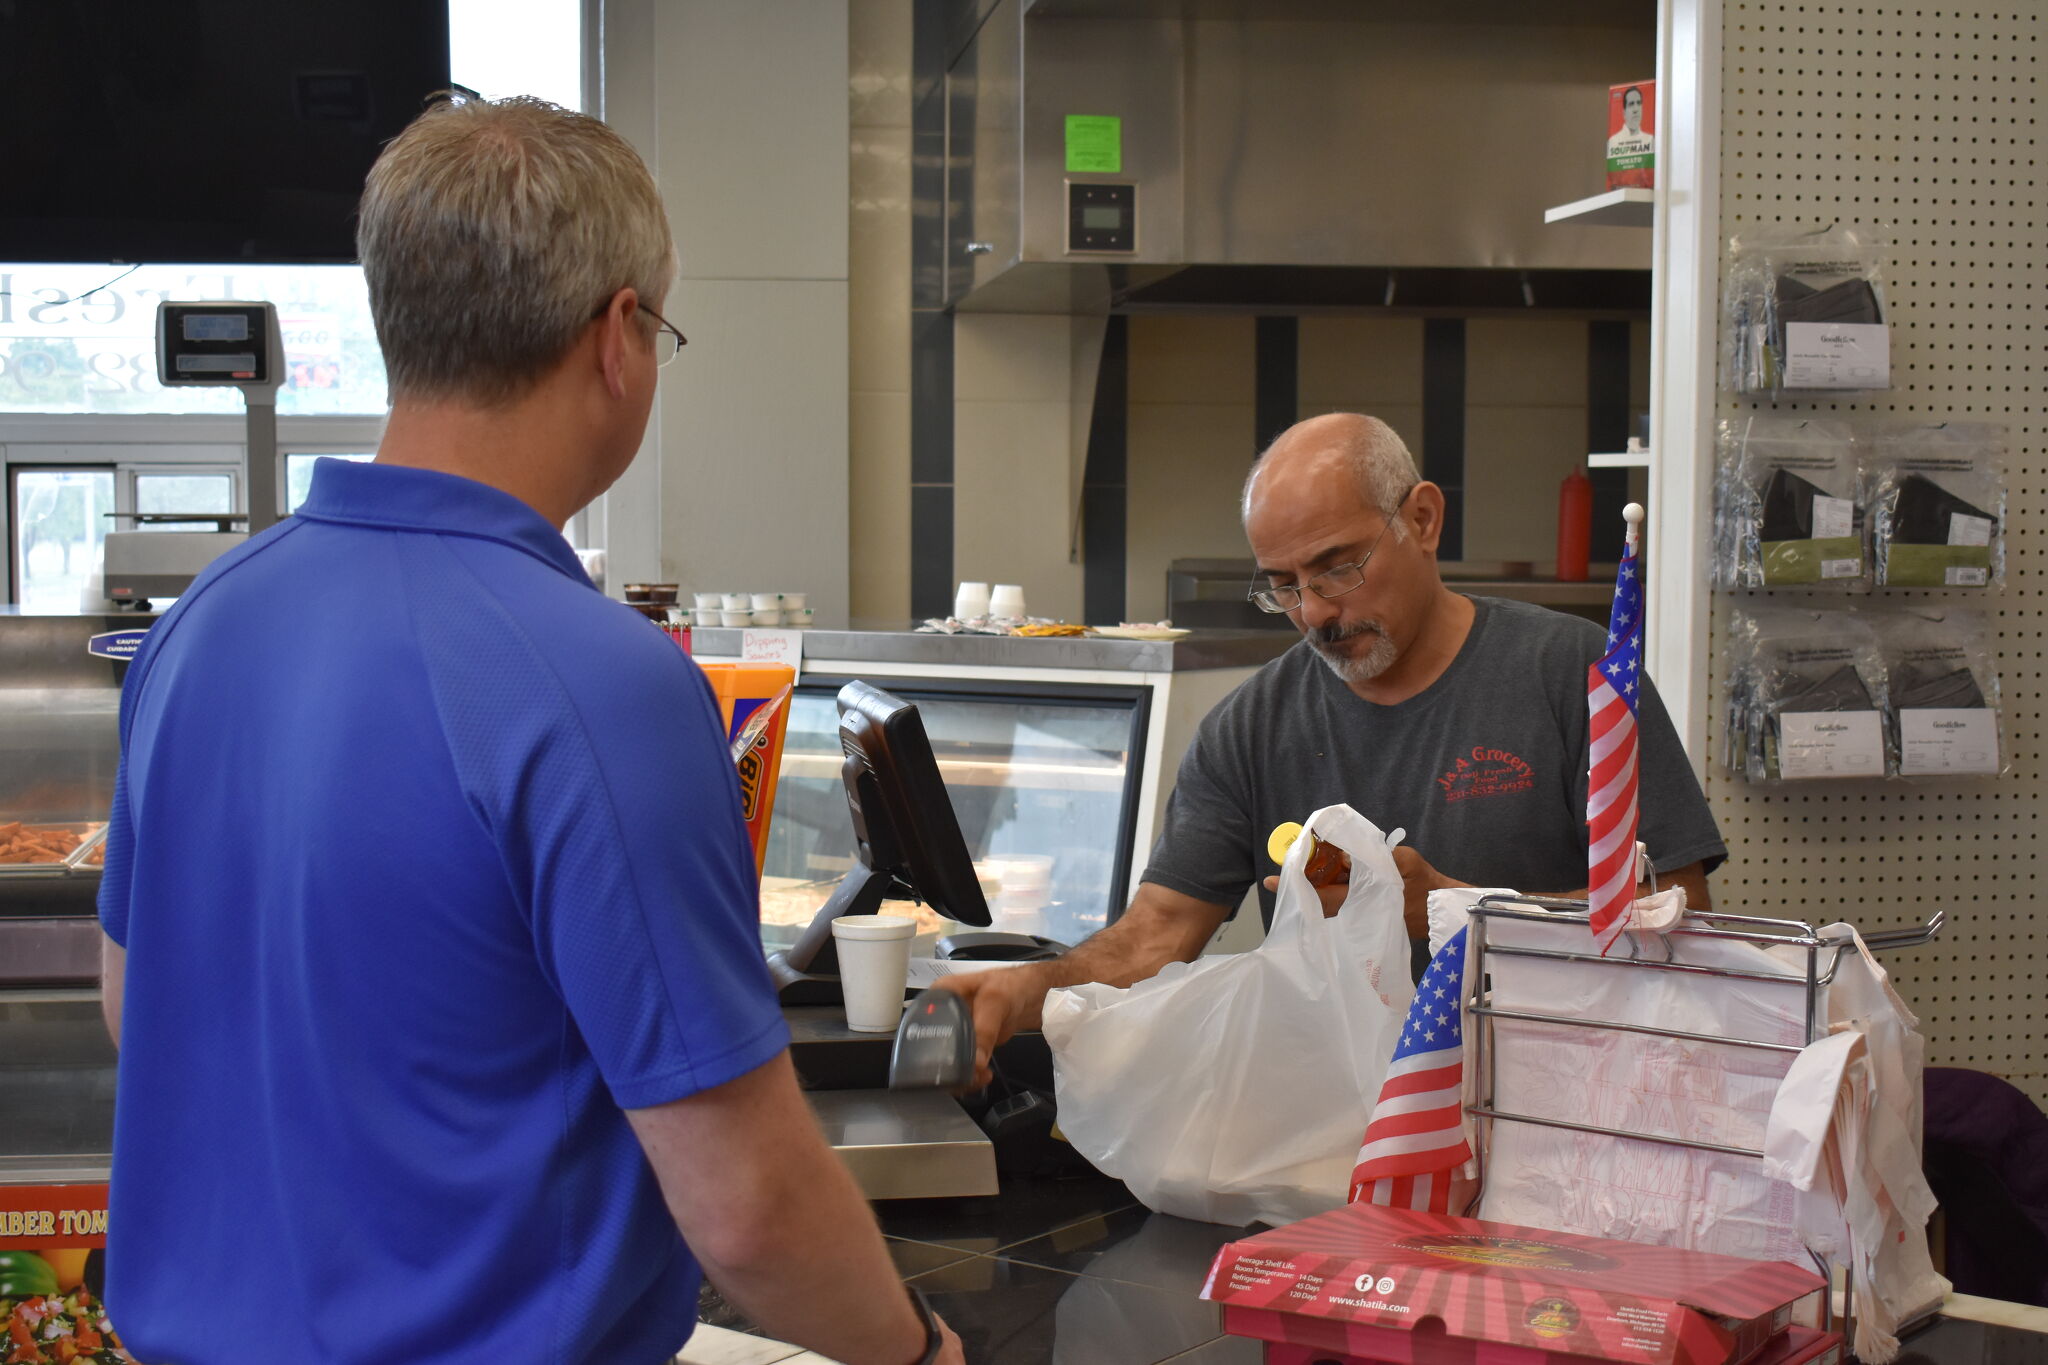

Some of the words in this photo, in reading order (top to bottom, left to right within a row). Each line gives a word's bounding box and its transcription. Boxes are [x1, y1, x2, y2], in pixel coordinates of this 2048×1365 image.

[1471, 746, 1535, 778] Grocery
[1237, 1255, 1264, 1266] Average
[1265, 1259, 1282, 1268] Shelf
[1282, 1261, 1297, 1270] Life:
[1231, 1272, 1271, 1285] Refrigerated:
[1295, 1282, 1304, 1290] 45
[1304, 1283, 1320, 1293] Days
[1234, 1264, 1254, 1273] Room
[1254, 1267, 1295, 1279] Temperature:
[1299, 1273, 1307, 1281] 14
[1307, 1274, 1323, 1284] Days
[1229, 1281, 1252, 1291] Frozen:
[1289, 1290, 1301, 1298] 120
[1301, 1292, 1318, 1301] Days
[1328, 1295, 1410, 1313] www.shatila.com
